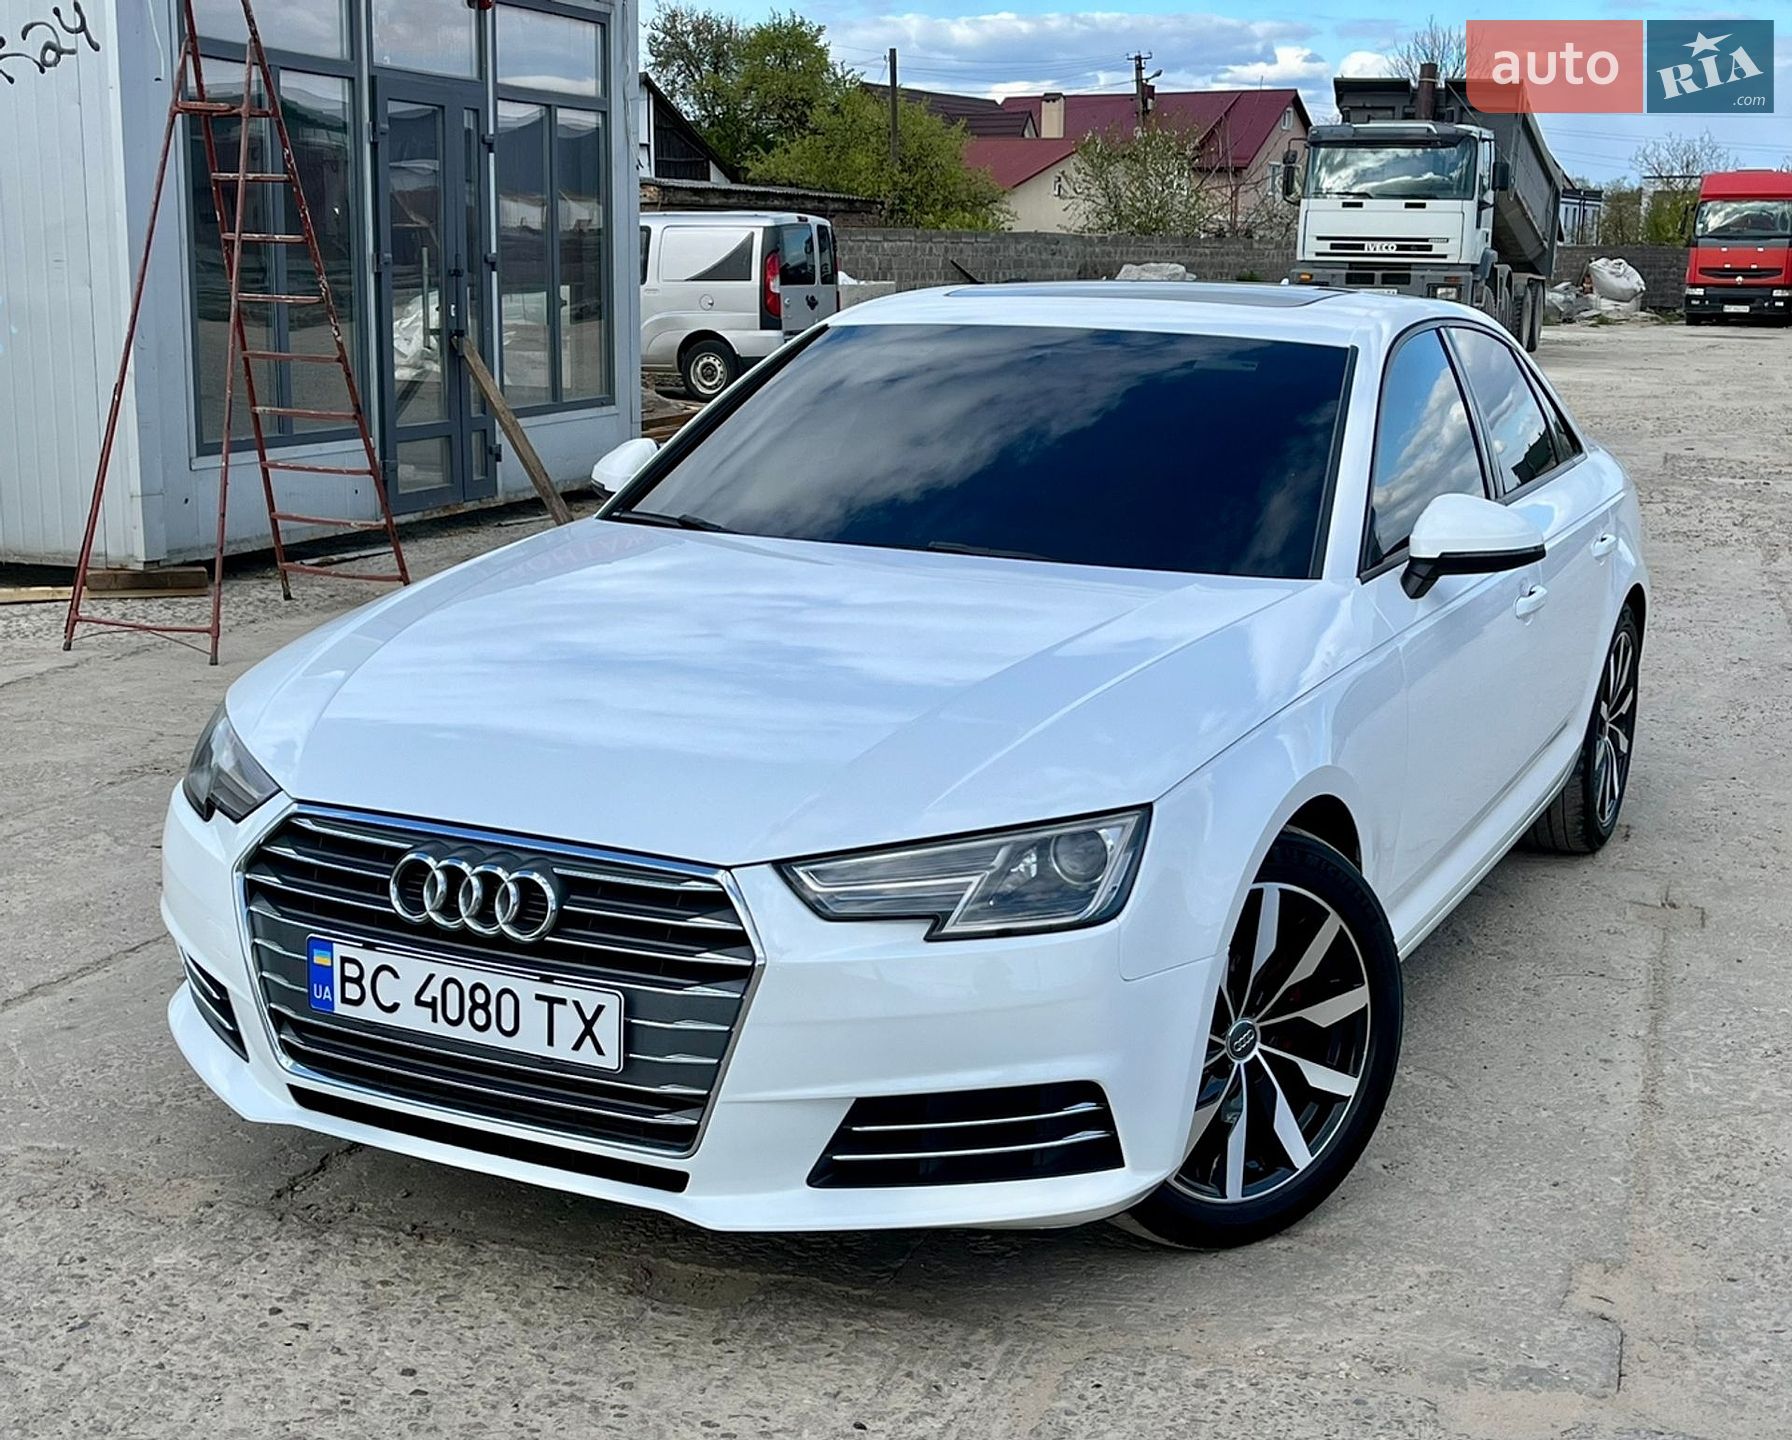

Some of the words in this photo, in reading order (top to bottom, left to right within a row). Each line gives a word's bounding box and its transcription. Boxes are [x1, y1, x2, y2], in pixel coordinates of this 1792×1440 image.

[1364, 243, 1397, 252] IVECO
[313, 983, 332, 1002] UA
[339, 955, 400, 1013] BC
[414, 972, 520, 1038] 4080
[534, 992, 606, 1056] TX
